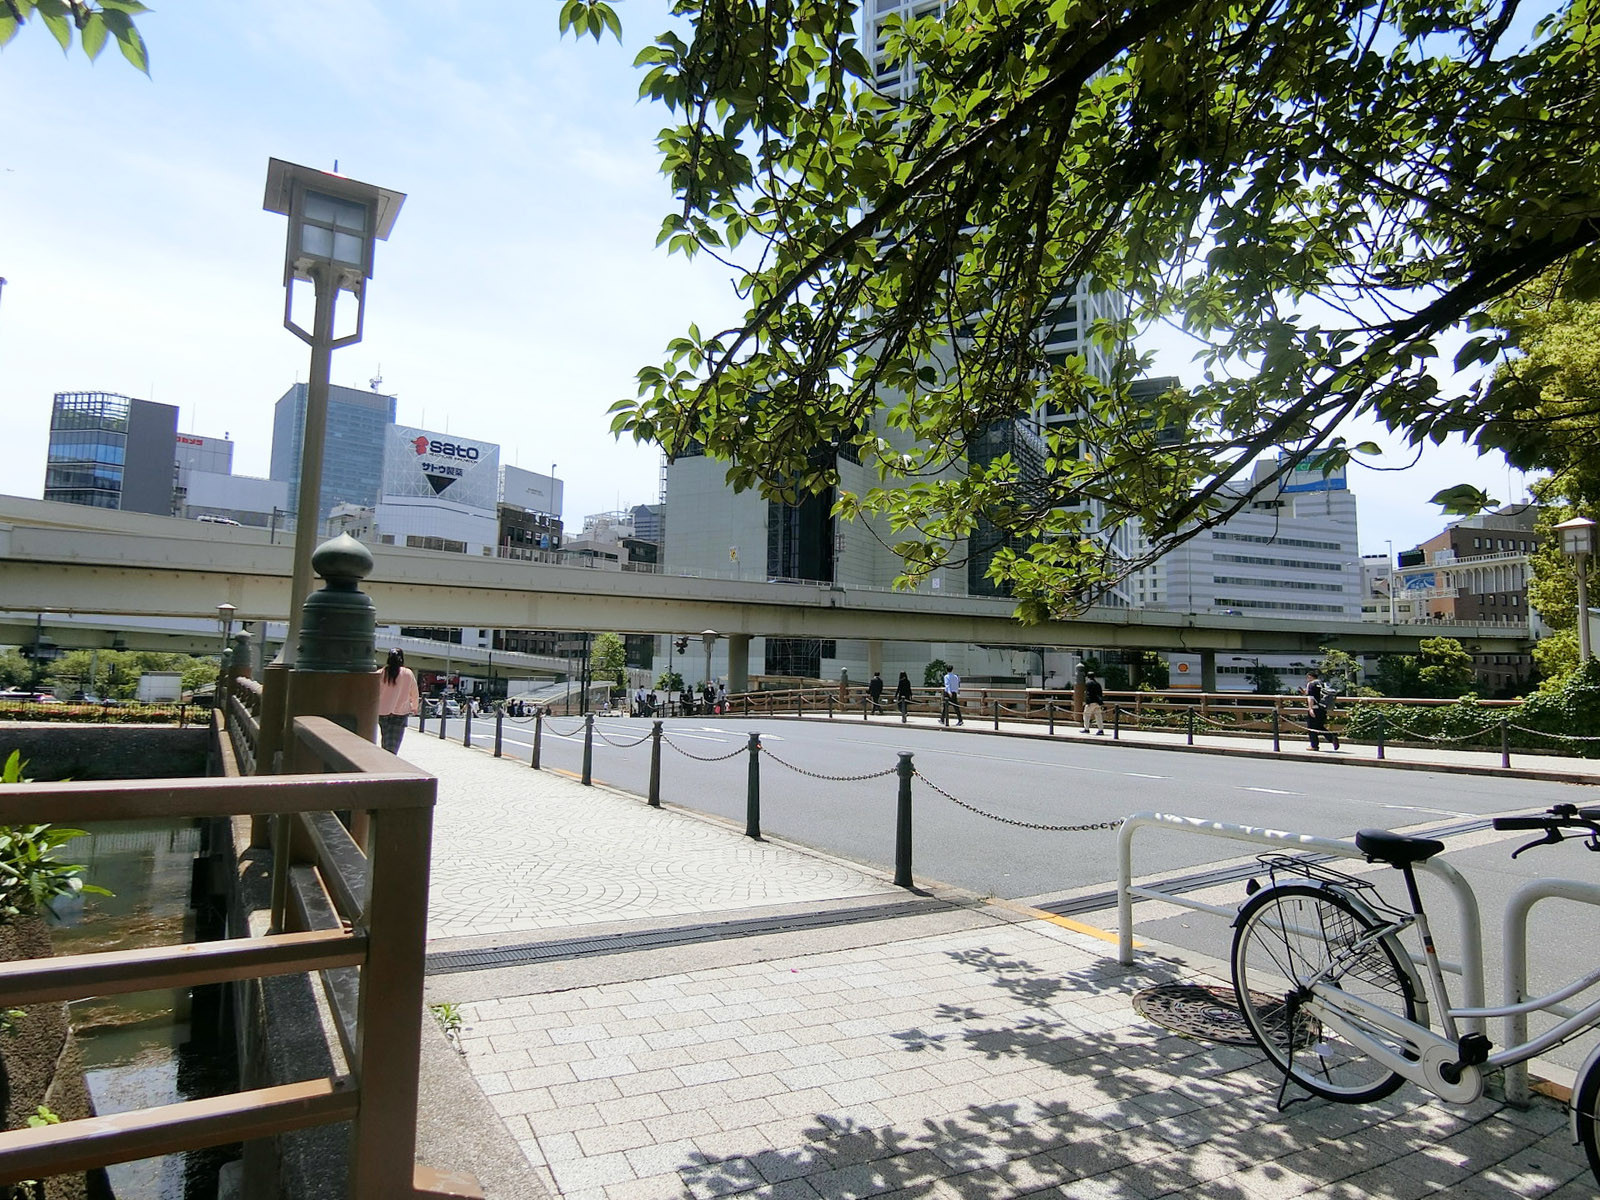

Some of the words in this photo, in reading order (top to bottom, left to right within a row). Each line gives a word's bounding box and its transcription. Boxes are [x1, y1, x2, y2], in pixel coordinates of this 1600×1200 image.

[429, 440, 479, 460] sato
[421, 462, 464, 477] サトウ製薬
